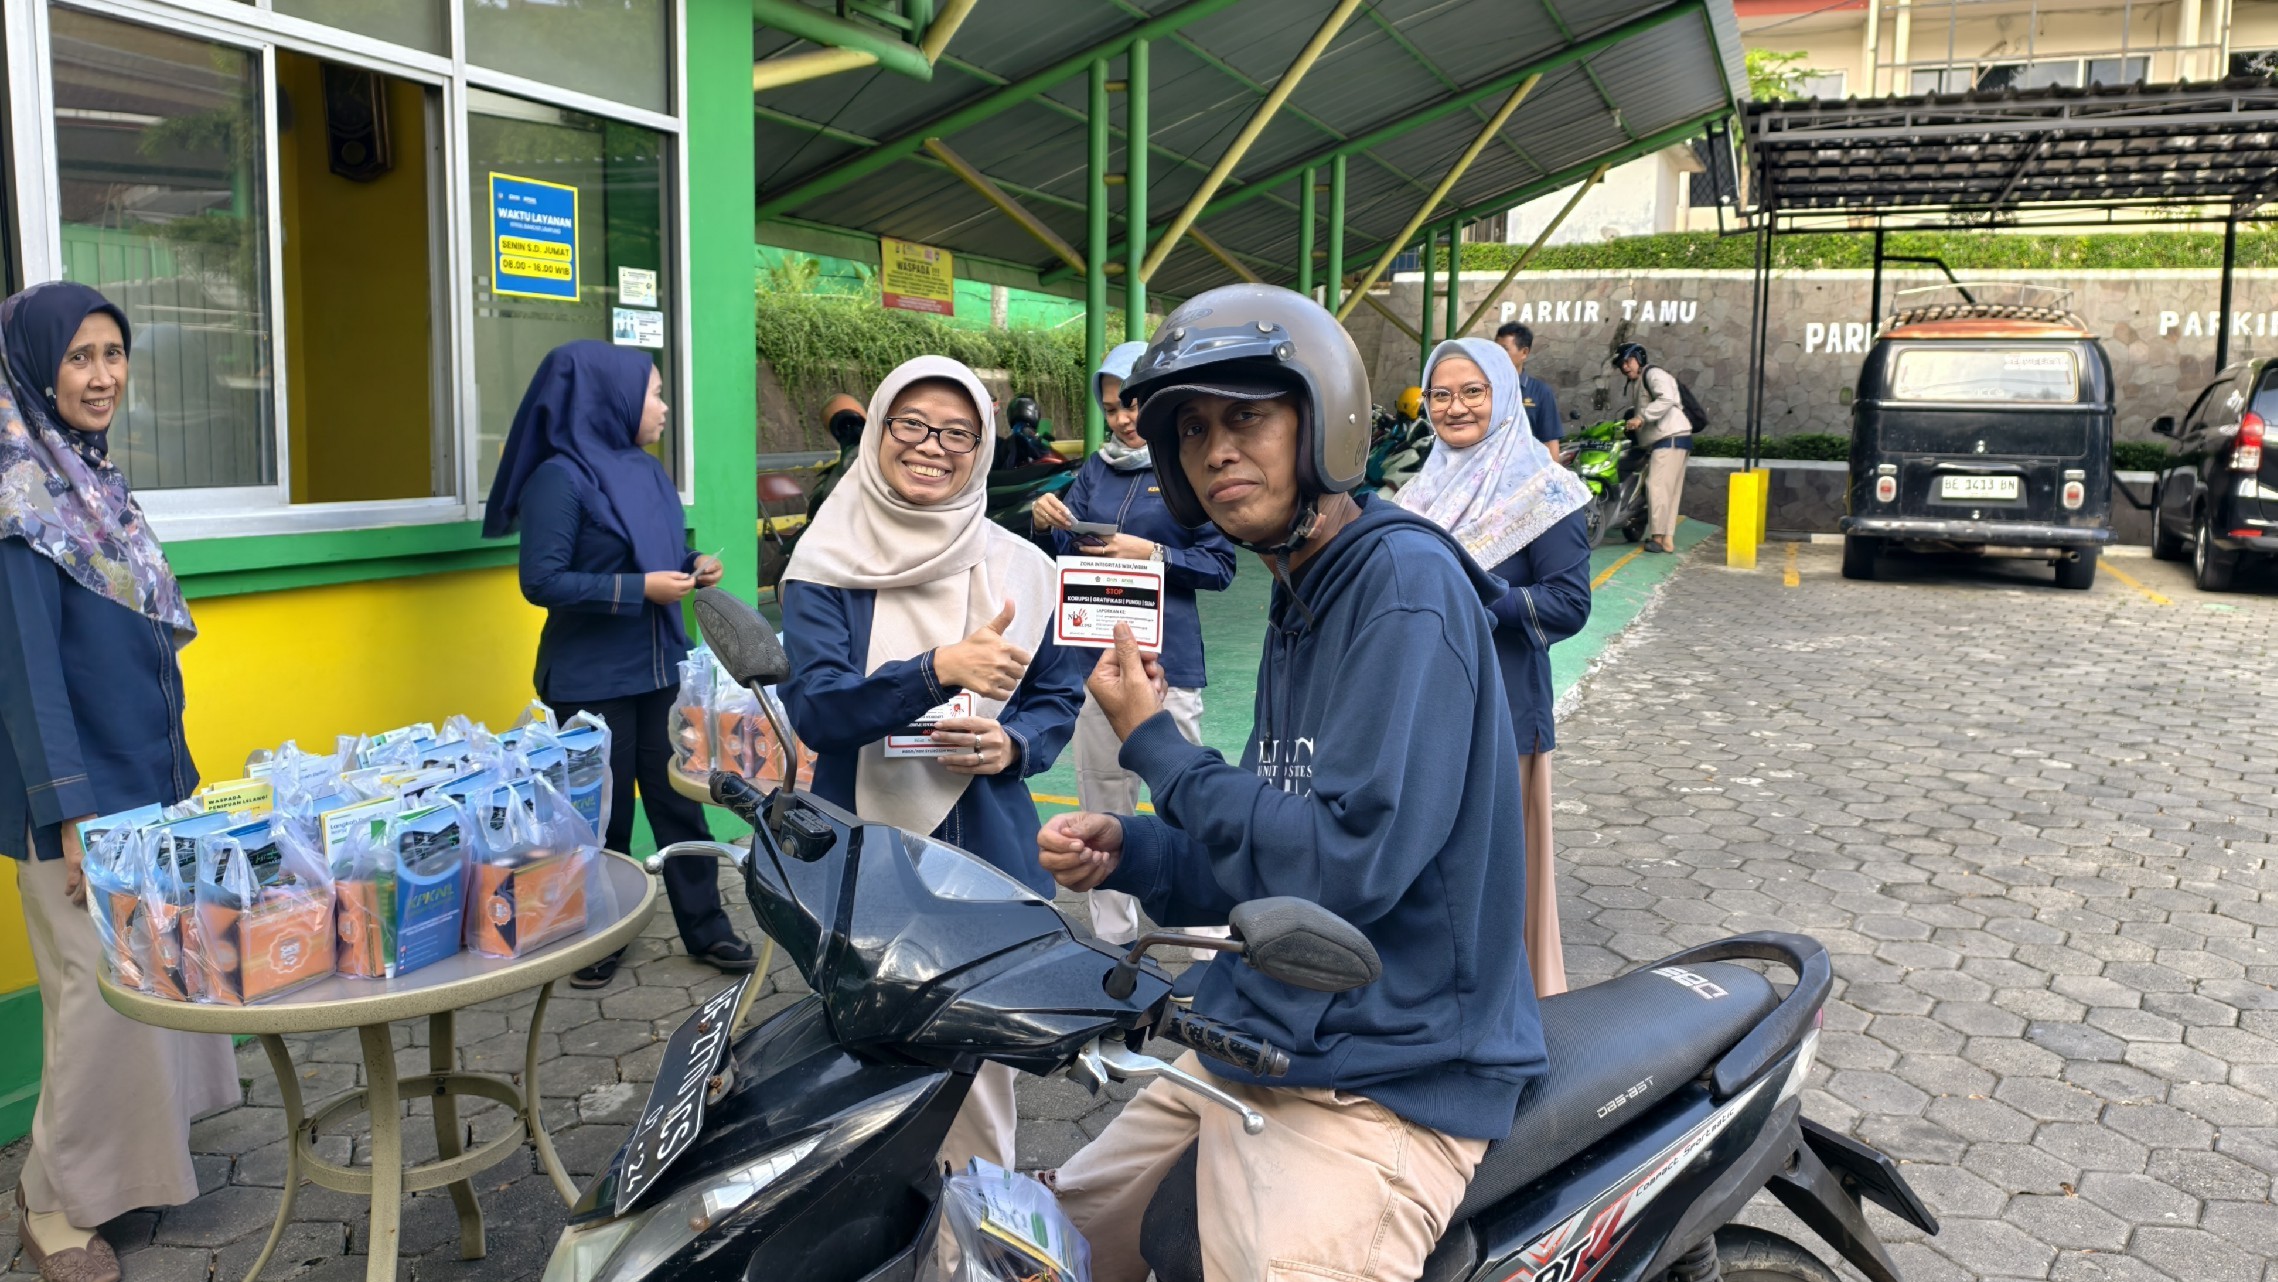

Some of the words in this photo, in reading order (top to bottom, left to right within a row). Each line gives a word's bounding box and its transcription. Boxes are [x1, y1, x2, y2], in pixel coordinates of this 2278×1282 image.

[497, 207, 531, 221] WAKTU
[532, 212, 572, 228] LAYANAN
[502, 240, 526, 251] SENIN
[527, 243, 542, 253] S.D.
[544, 246, 570, 257] JUMAT
[503, 259, 526, 270] 08.00
[555, 266, 570, 276] WIB
[896, 261, 931, 276] WASPADA
[1500, 300, 1600, 323] PARKIR
[1621, 300, 1697, 323] TAMU
[208, 794, 241, 805] WASPADA
